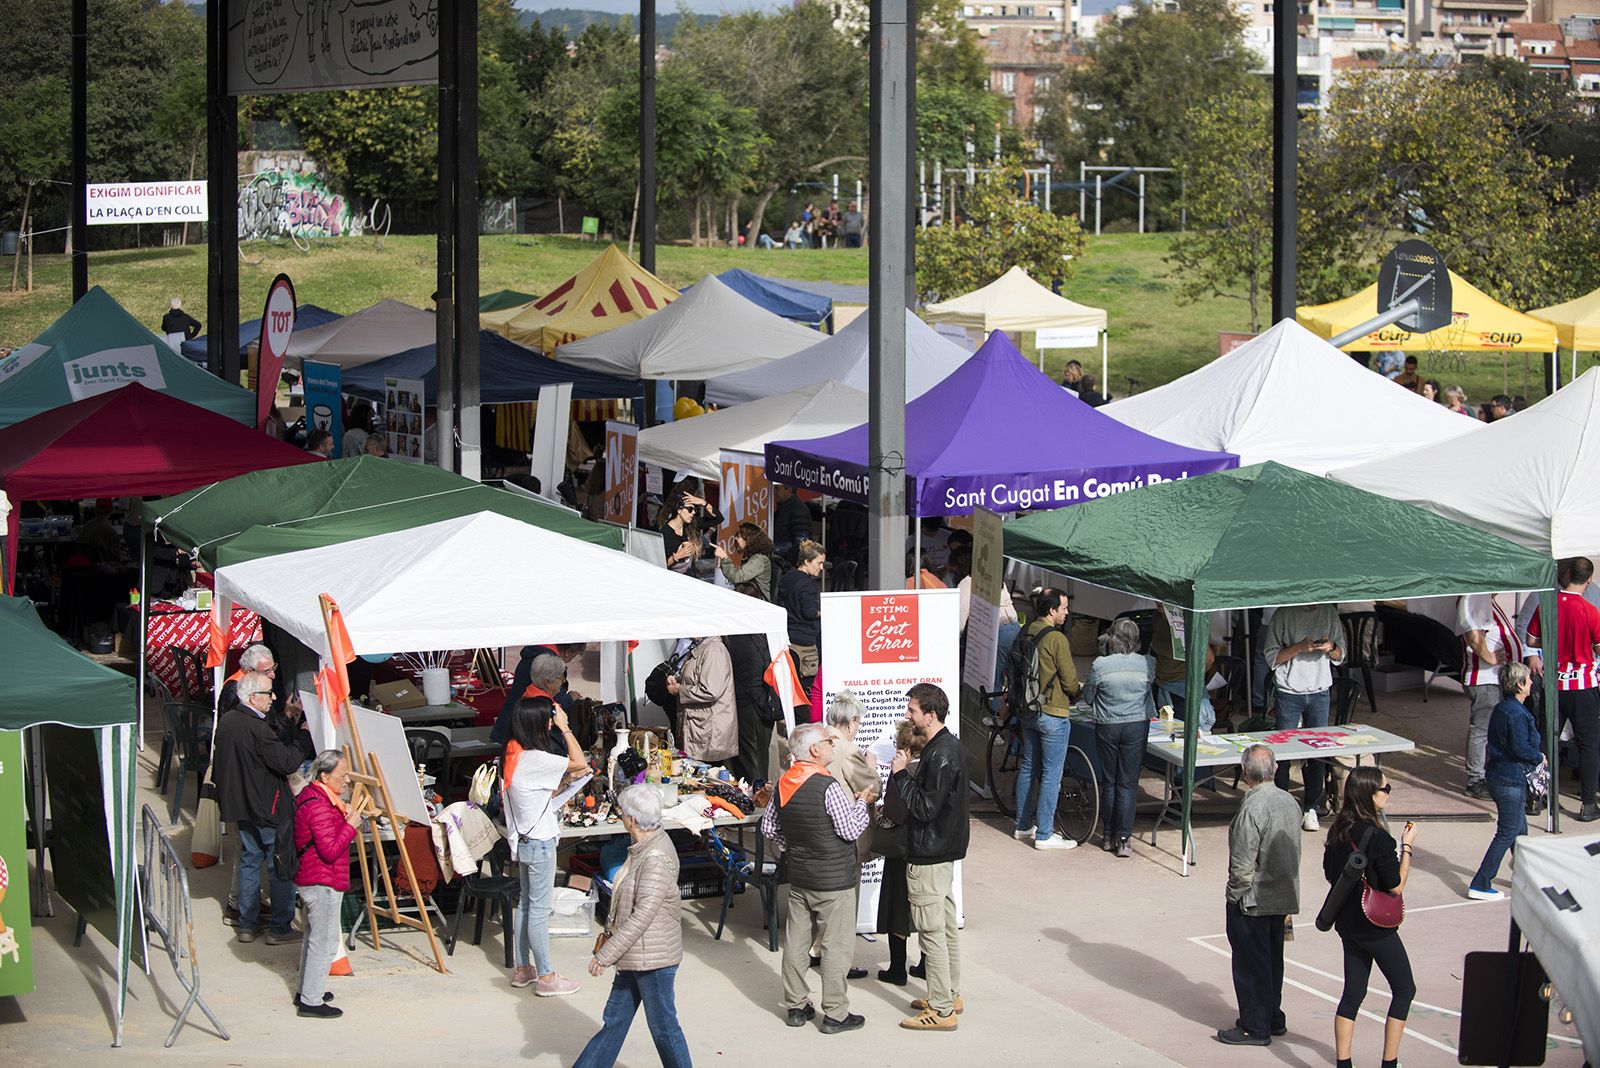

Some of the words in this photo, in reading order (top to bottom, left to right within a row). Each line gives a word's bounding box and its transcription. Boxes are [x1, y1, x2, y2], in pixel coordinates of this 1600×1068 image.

[90, 187, 131, 198] EXIGIM
[134, 186, 201, 196] DIGNIFICAR
[90, 208, 104, 218] LA
[106, 207, 142, 218] PLAÇA
[146, 206, 171, 216] D'EN
[174, 206, 202, 215] COLL
[271, 311, 291, 334] TOT
[72, 362, 146, 384] junts
[605, 431, 635, 493] Wise
[774, 455, 793, 476] Sant
[794, 460, 820, 487] Cugat
[820, 466, 832, 487] En
[832, 470, 862, 494] Comú
[719, 461, 769, 530] Wise
[944, 488, 986, 508] Sant
[992, 484, 1050, 508] Cugat
[1054, 480, 1079, 500] En
[1083, 476, 1143, 498] Comú
[870, 606, 909, 614] ESTIMO
[883, 614, 896, 622] LA
[866, 620, 912, 639] Gent
[868, 636, 913, 652] Gran
